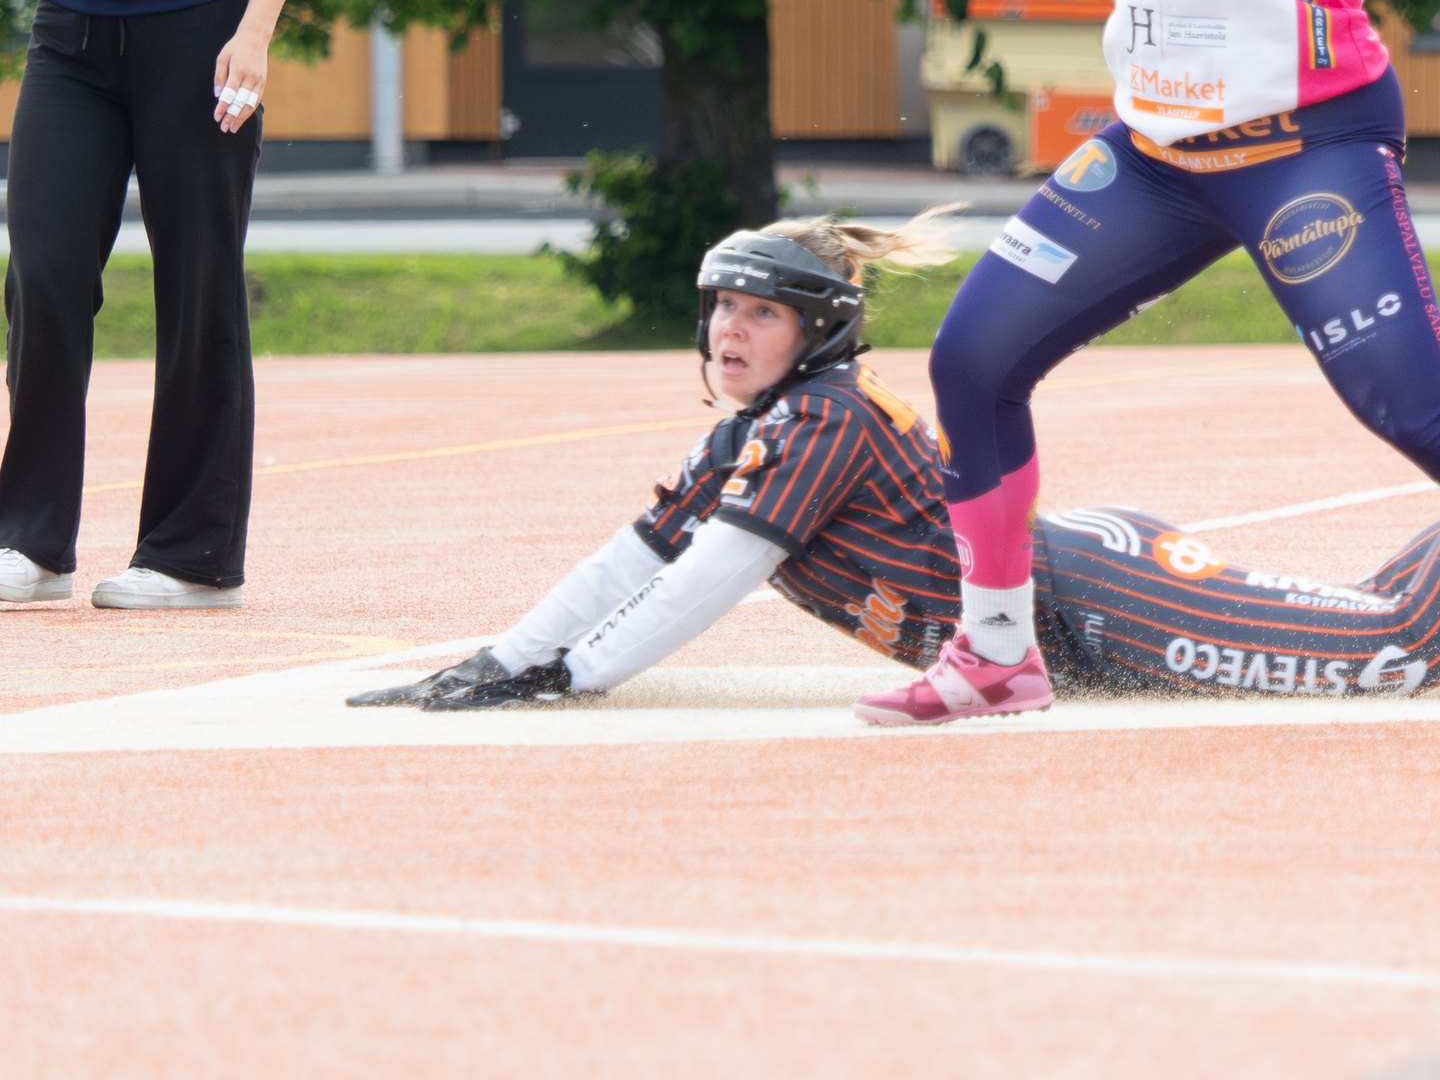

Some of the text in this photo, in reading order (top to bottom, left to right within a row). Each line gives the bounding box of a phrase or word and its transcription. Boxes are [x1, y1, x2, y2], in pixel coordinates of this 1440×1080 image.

[1158, 146, 1247, 169] YLÄMYLLY
[1385, 159, 1432, 300] TAOUSPALVELU
[1310, 293, 1402, 352] ISLO
[1165, 636, 1351, 697] STEVECO
